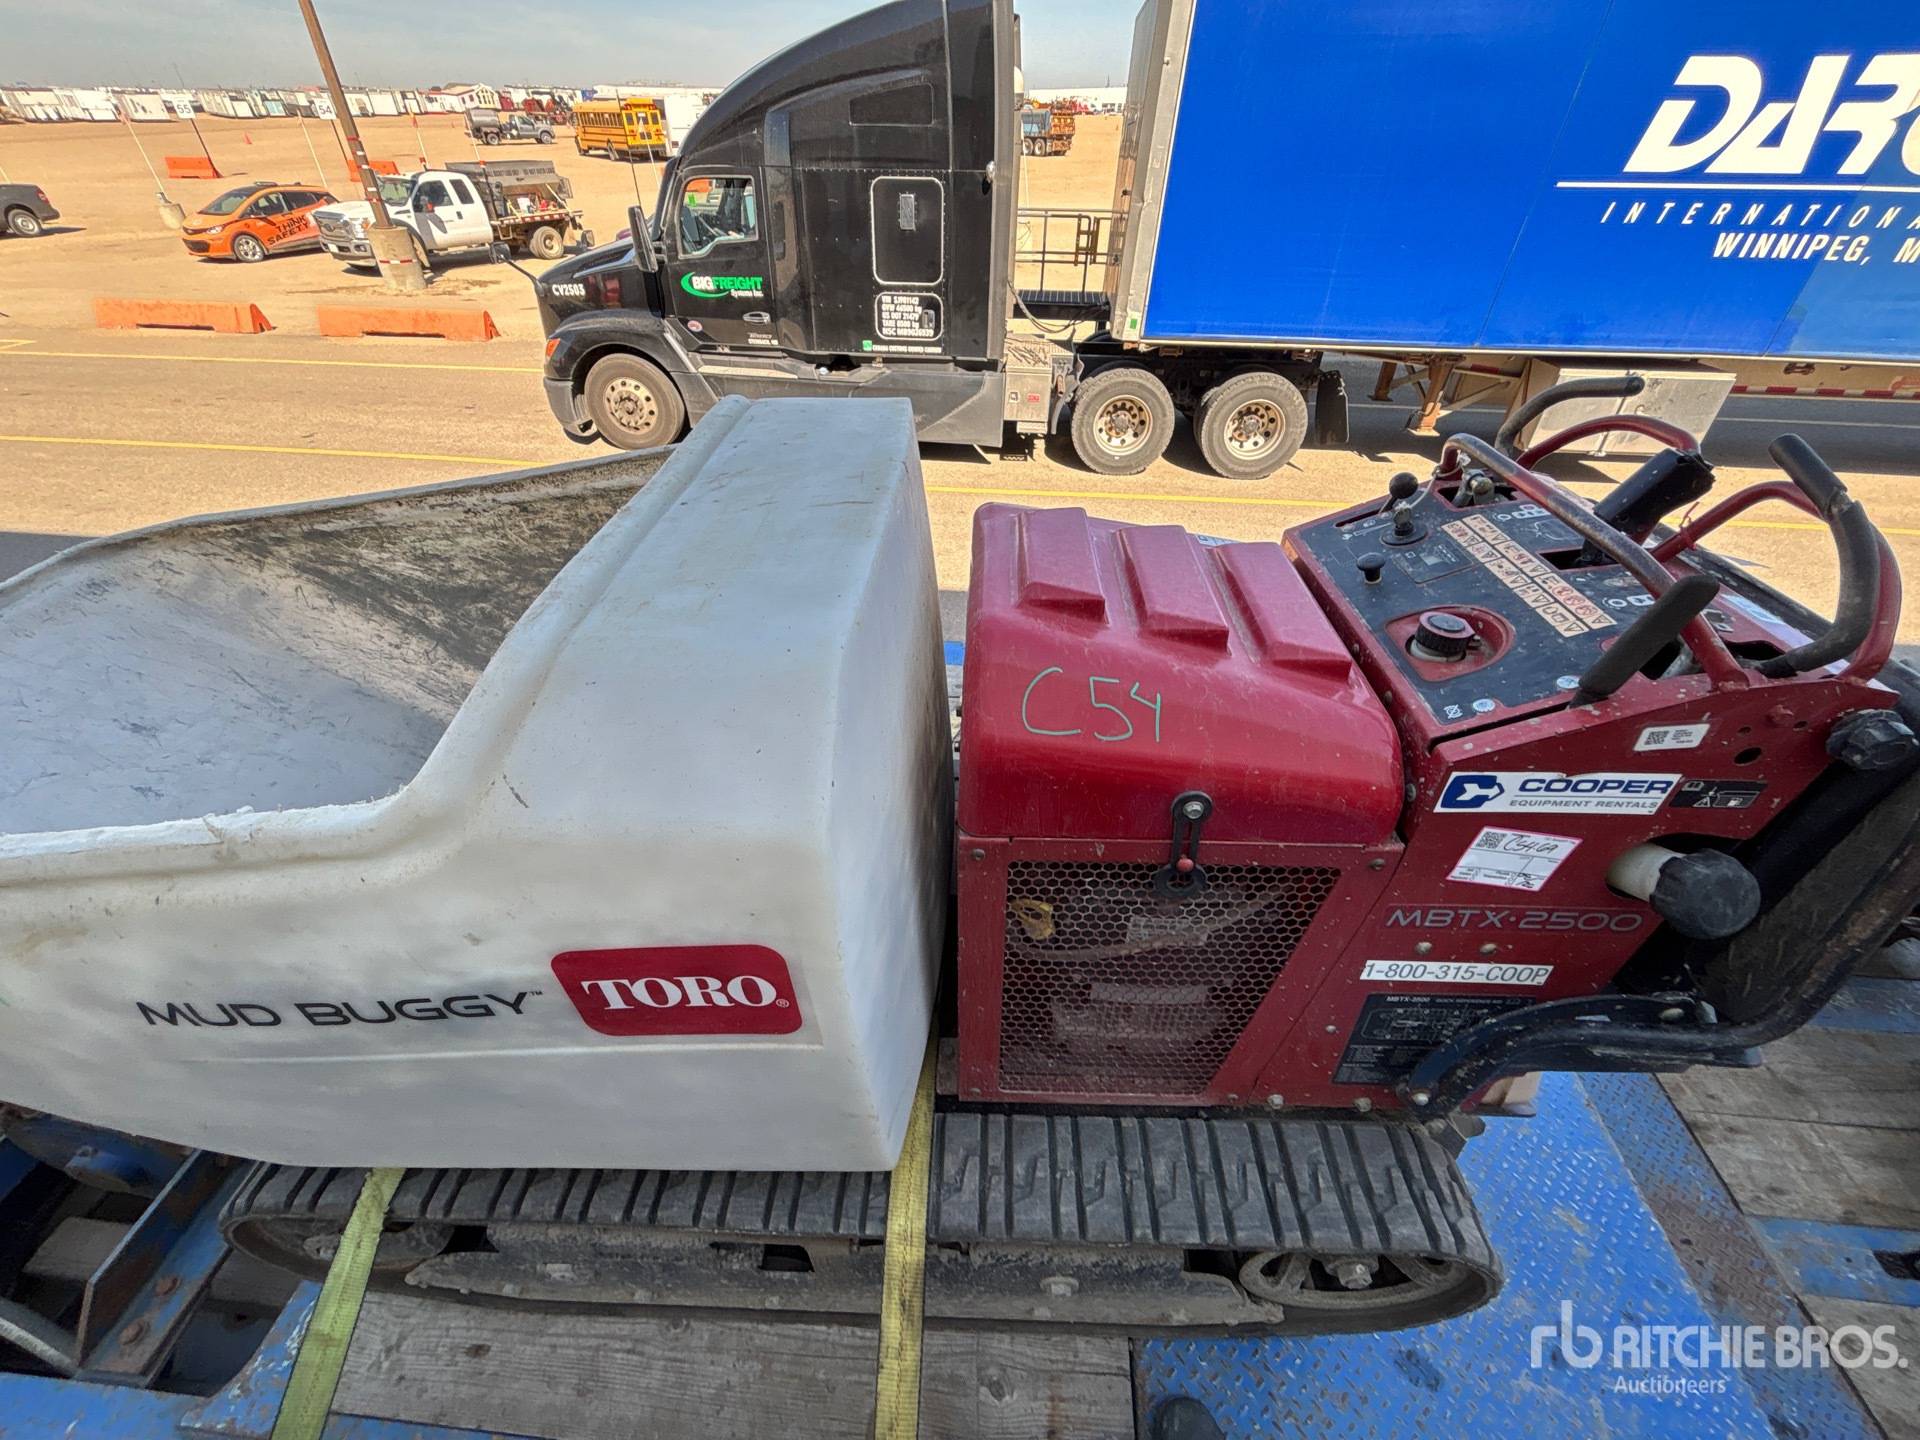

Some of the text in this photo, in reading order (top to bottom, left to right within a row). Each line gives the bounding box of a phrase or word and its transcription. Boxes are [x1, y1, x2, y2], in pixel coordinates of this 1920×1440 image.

[177, 104, 191, 114] 55
[319, 105, 333, 115] 54
[1623, 54, 1920, 176] DAR
[275, 215, 306, 232] THINK
[267, 222, 309, 245] SAFETY
[1713, 232, 1870, 266] WINNIPEG,
[552, 284, 586, 296] CV2503
[1022, 667, 1161, 742] C54
[1518, 779, 1674, 794] COOPER
[1509, 799, 1658, 809] EQUIPMENT RENTALS
[1366, 963, 1550, 983] 1-800-315-COOP
[137, 1001, 281, 1027] MUD
